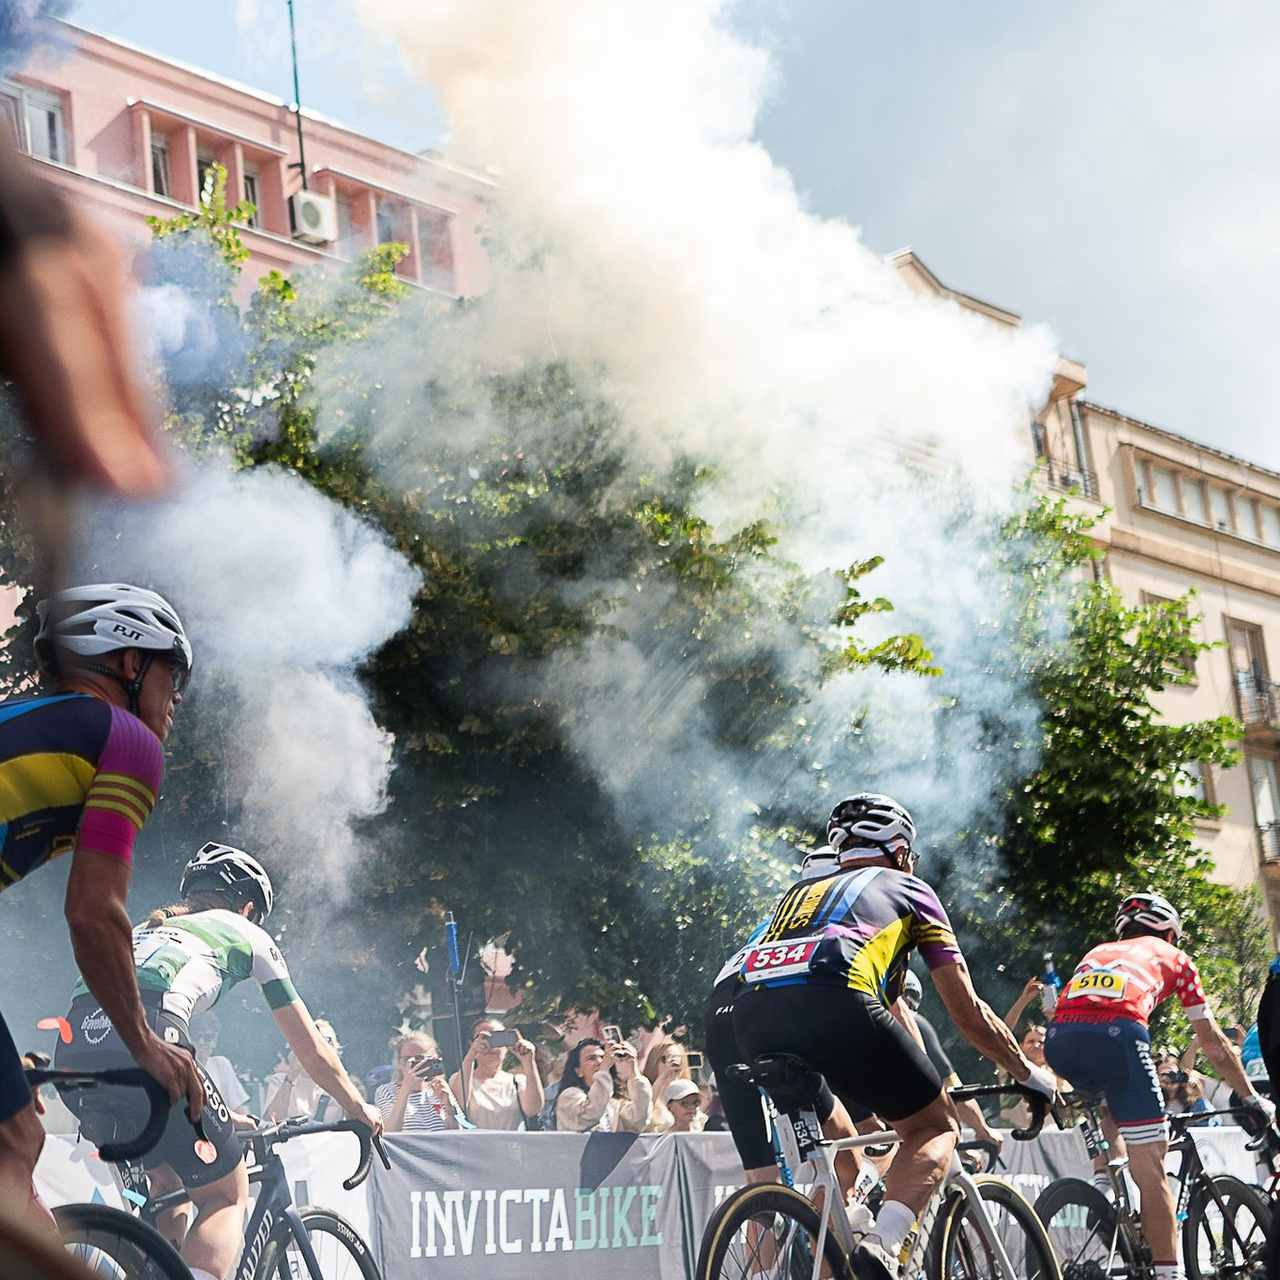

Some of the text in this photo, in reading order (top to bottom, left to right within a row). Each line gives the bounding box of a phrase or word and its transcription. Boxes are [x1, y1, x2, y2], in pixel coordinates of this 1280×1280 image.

[753, 943, 806, 968] 534
[1078, 975, 1114, 989] 510
[793, 1120, 812, 1148] 534
[410, 1185, 663, 1259] INVICTABIKE
